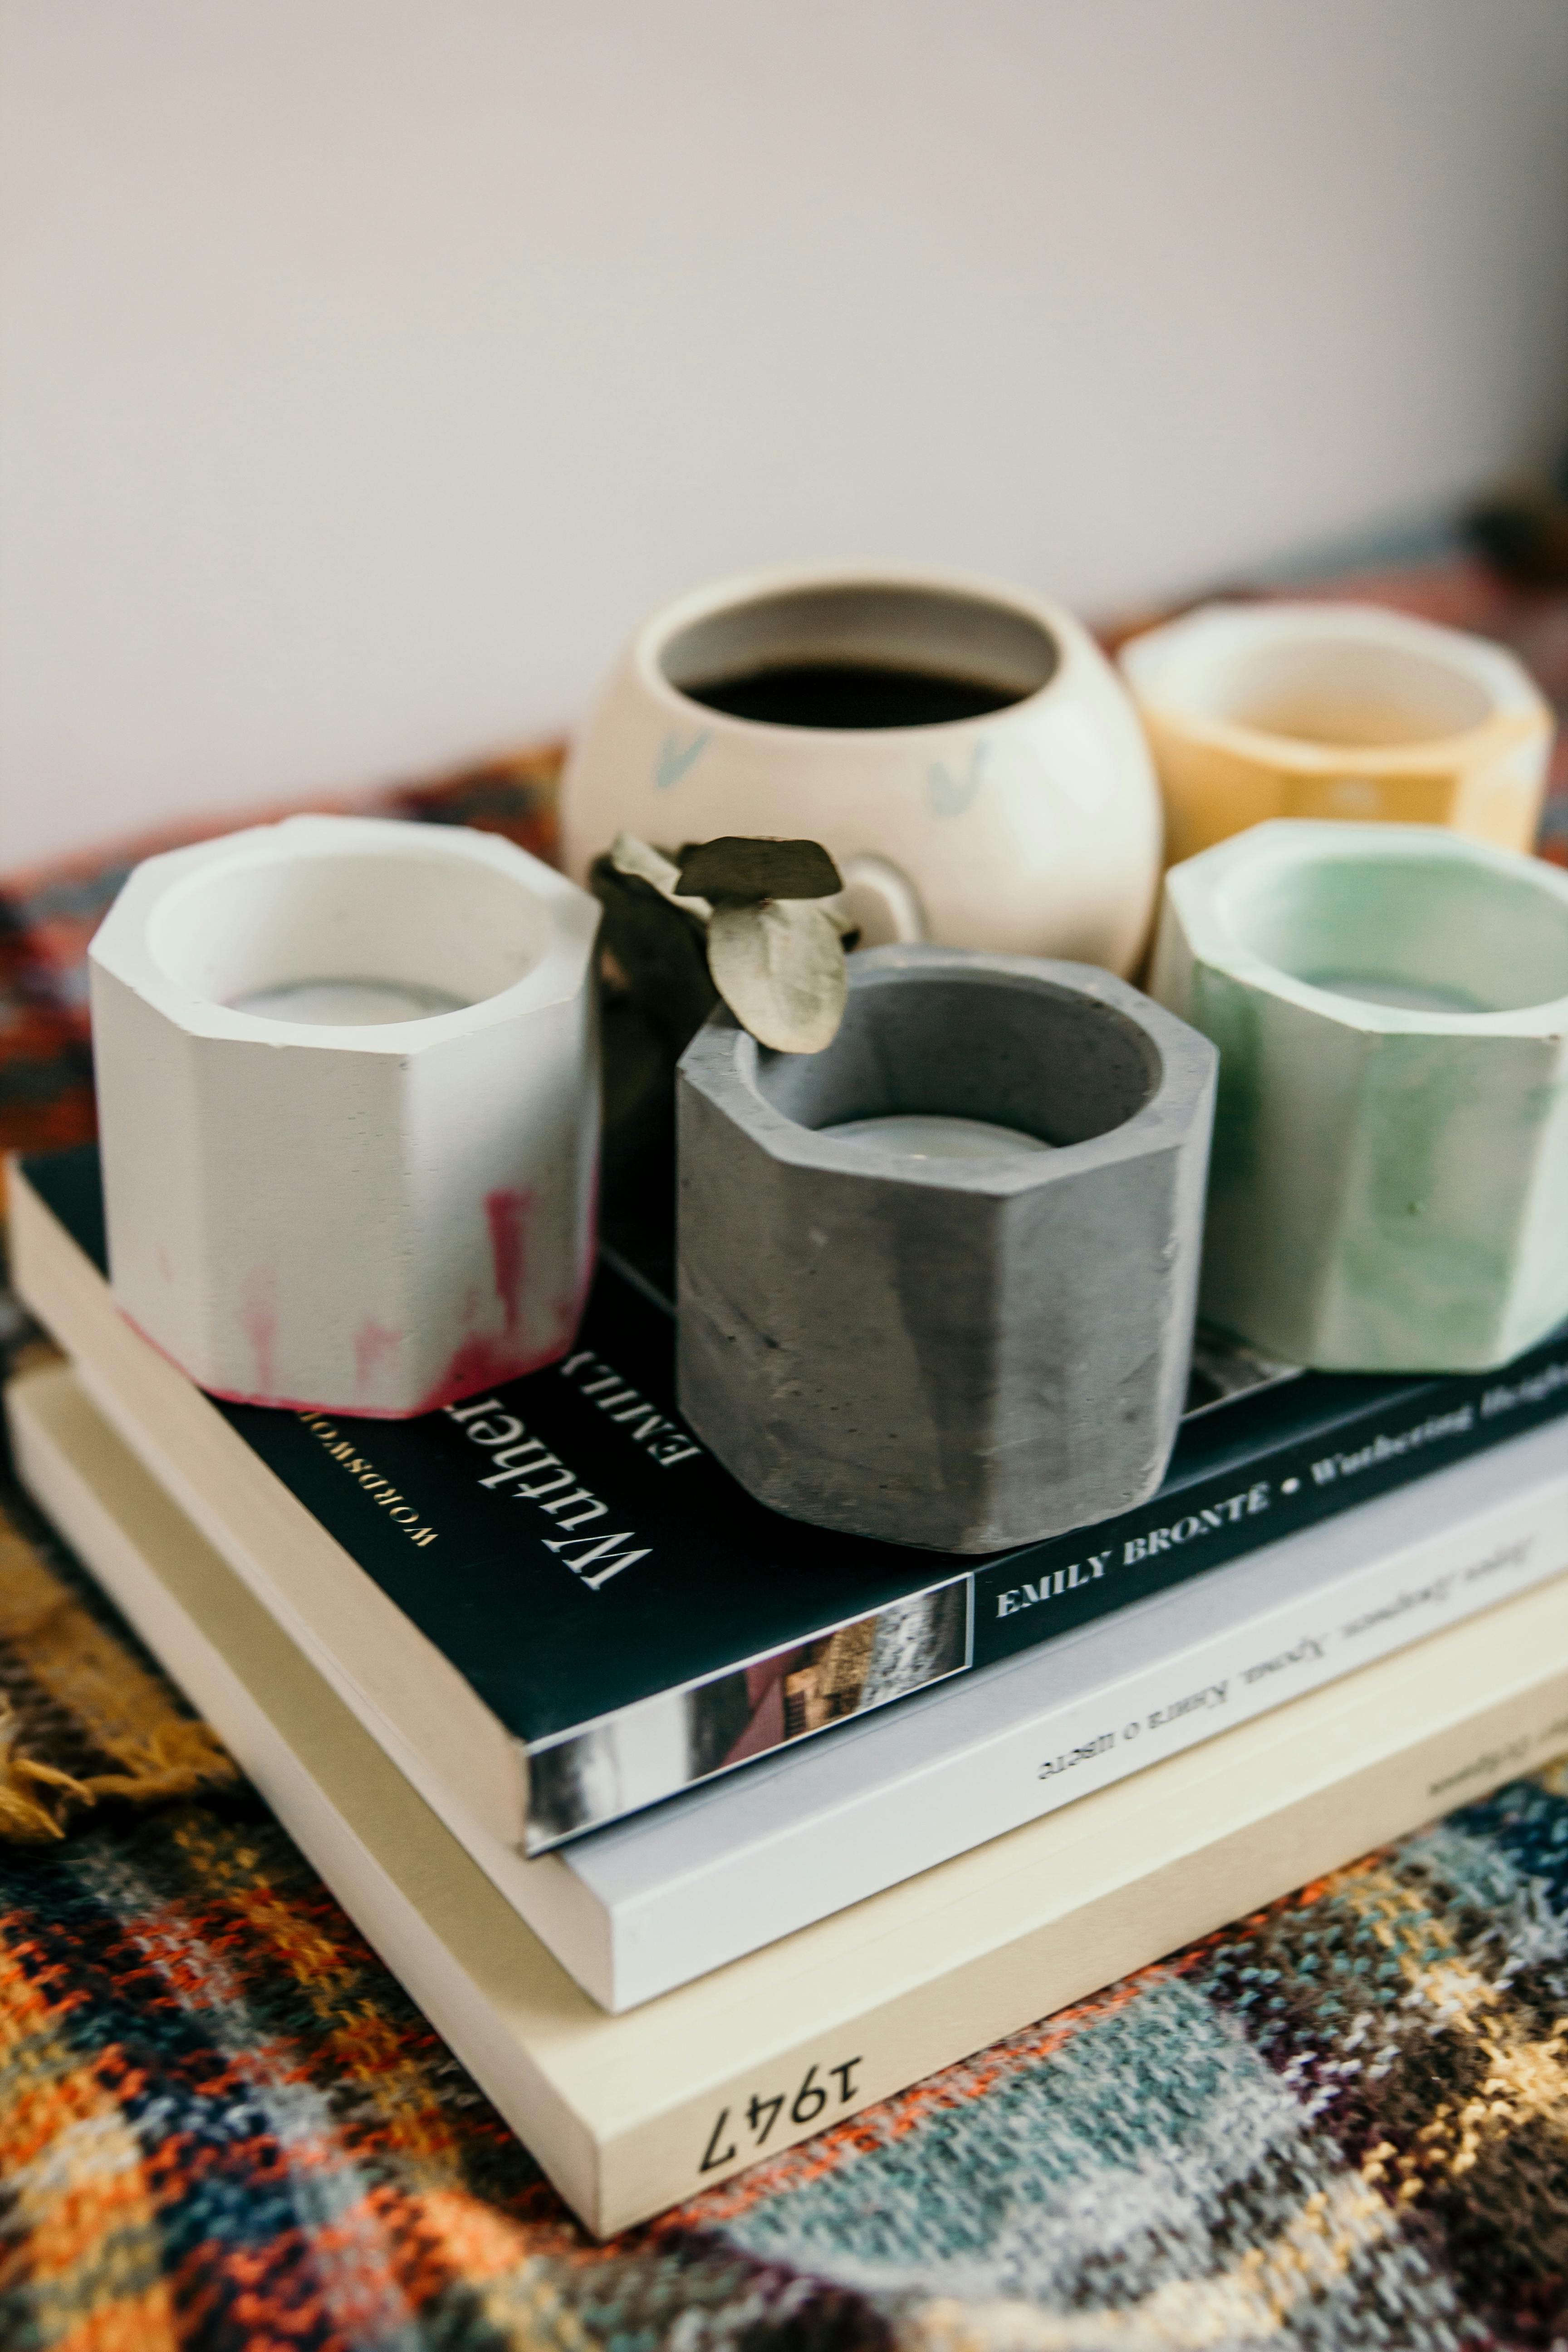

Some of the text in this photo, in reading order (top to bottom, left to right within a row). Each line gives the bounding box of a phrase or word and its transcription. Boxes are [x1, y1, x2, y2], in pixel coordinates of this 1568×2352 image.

[446, 1396, 653, 1590] Wuther
[996, 1550, 1112, 1617] EMILY
[699, 2055, 863, 2175] 1947
